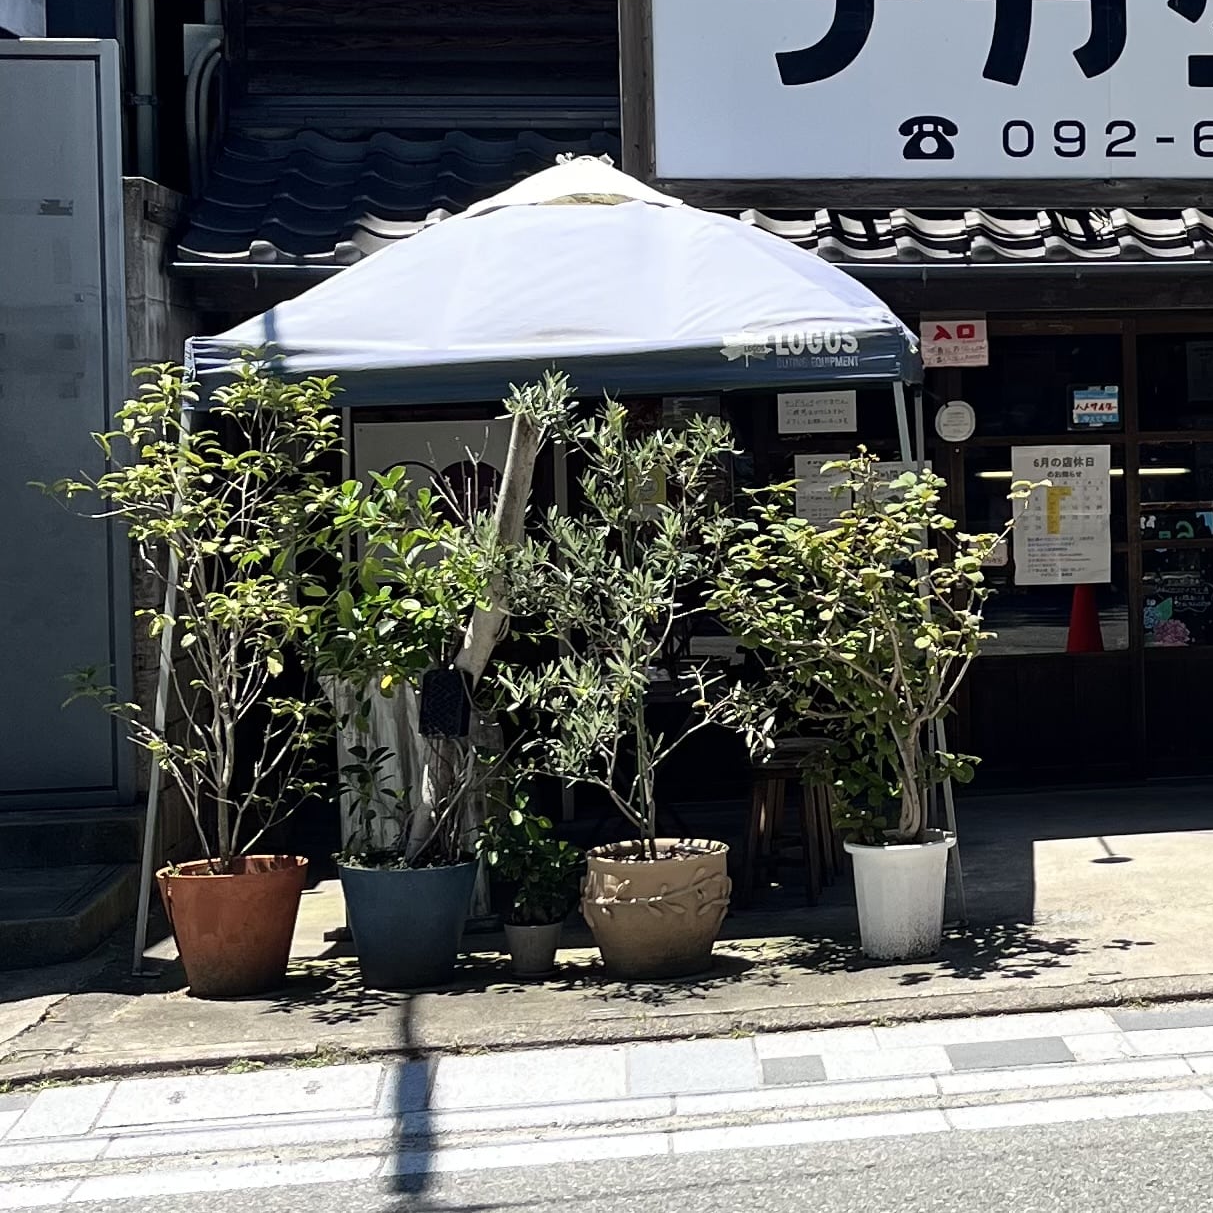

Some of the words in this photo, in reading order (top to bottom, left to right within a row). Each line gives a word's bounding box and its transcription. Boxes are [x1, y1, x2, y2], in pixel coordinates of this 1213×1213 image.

[932, 323, 975, 341] 入口
[775, 329, 858, 356] LOGOS
[1032, 456, 1095, 468] 6月の店休日
[1047, 470, 1083, 478] のお知らせ
